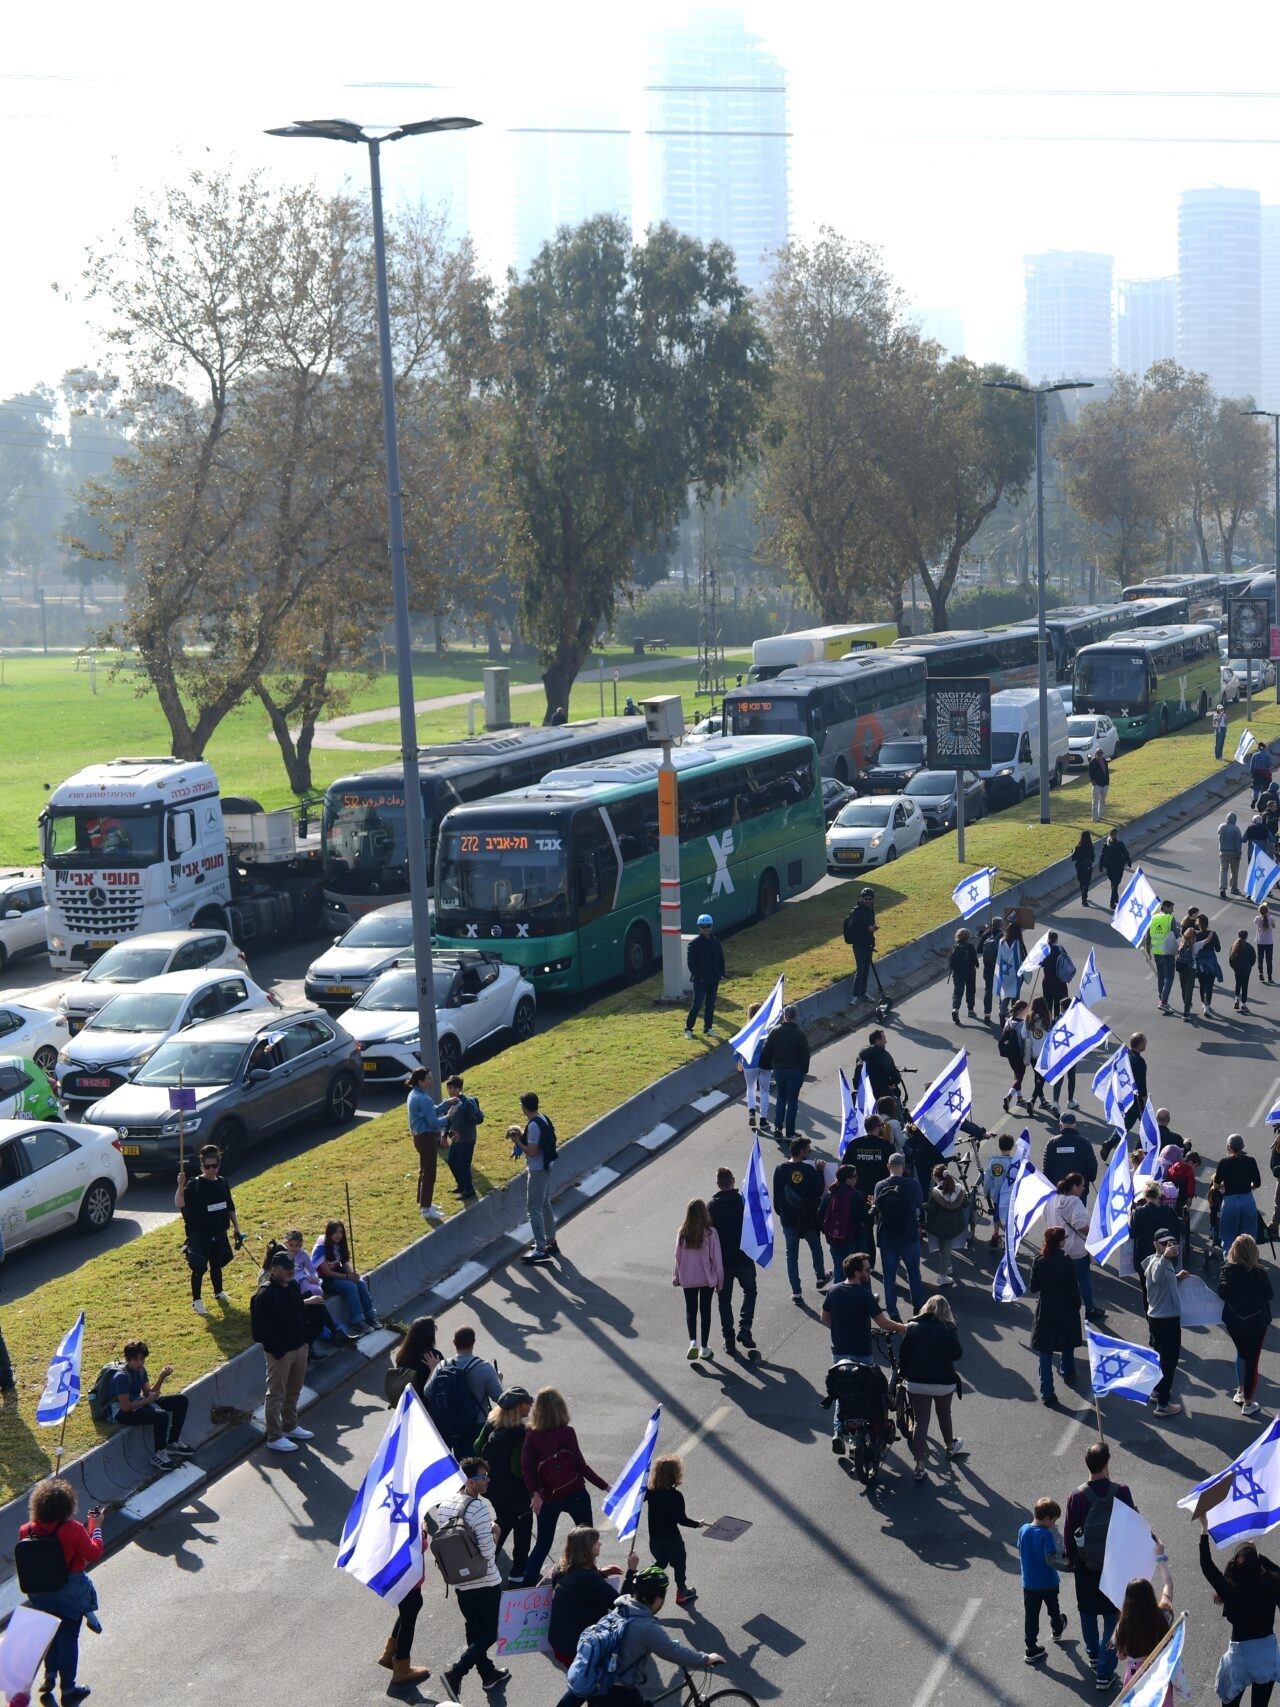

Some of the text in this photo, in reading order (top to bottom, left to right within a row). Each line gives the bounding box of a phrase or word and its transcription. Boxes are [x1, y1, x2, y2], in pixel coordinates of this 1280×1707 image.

[171, 781, 213, 799] הובלה כבדה
[460, 836, 528, 852] תל-אביב 272
[182, 853, 224, 878] מנופי אבי
[69, 871, 140, 886] מנופי אבי
[505, 1585, 553, 1623] לשטיין
[523, 1610, 549, 1625] ביל
[518, 1627, 548, 1638] שבת
